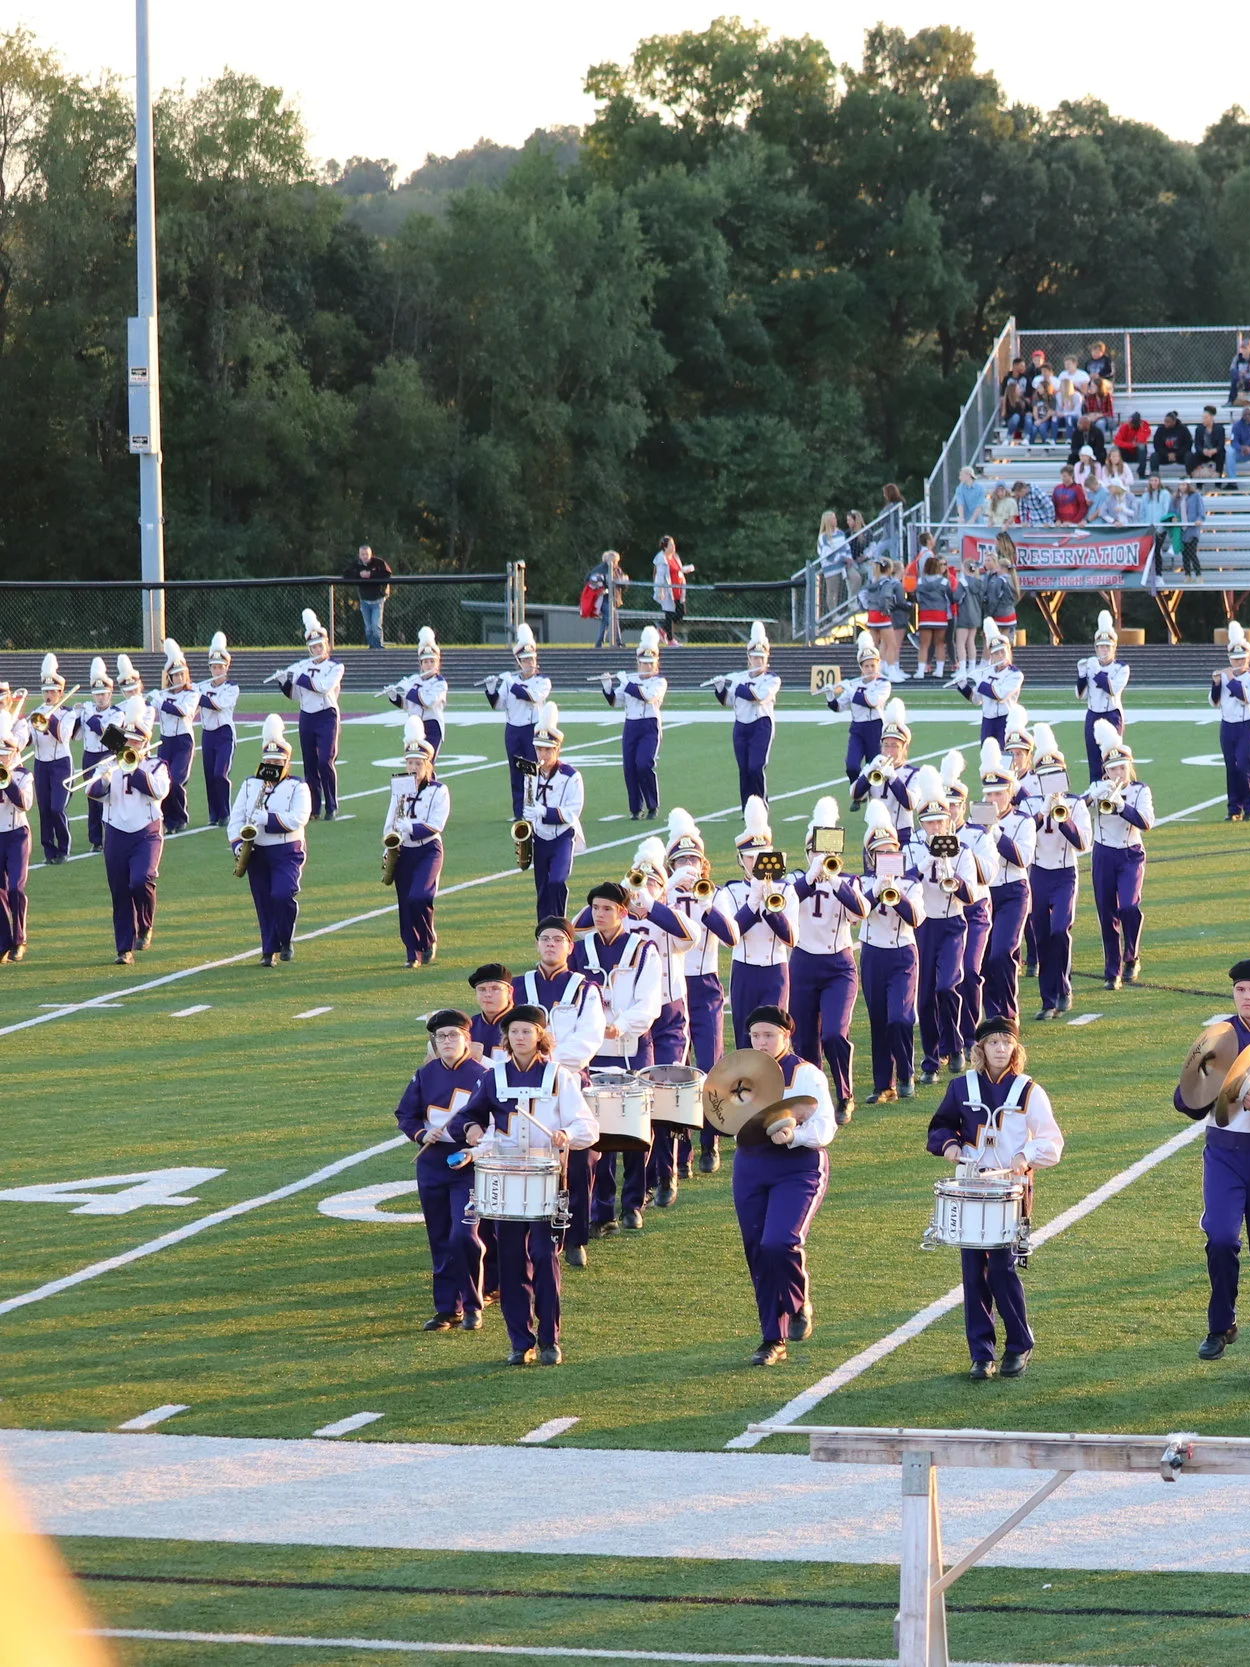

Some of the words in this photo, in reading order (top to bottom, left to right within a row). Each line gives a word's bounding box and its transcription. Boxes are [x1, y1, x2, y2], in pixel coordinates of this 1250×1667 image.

[1016, 542, 1140, 567] RESERVATION
[1085, 574, 1125, 585] SCHOOL
[815, 669, 836, 690] 30
[809, 889, 830, 918] T
[986, 1137, 994, 1146] M
[0, 1167, 229, 1216] 4
[491, 1179, 499, 1207] MAPEX
[950, 1205, 958, 1233] MAPEX
